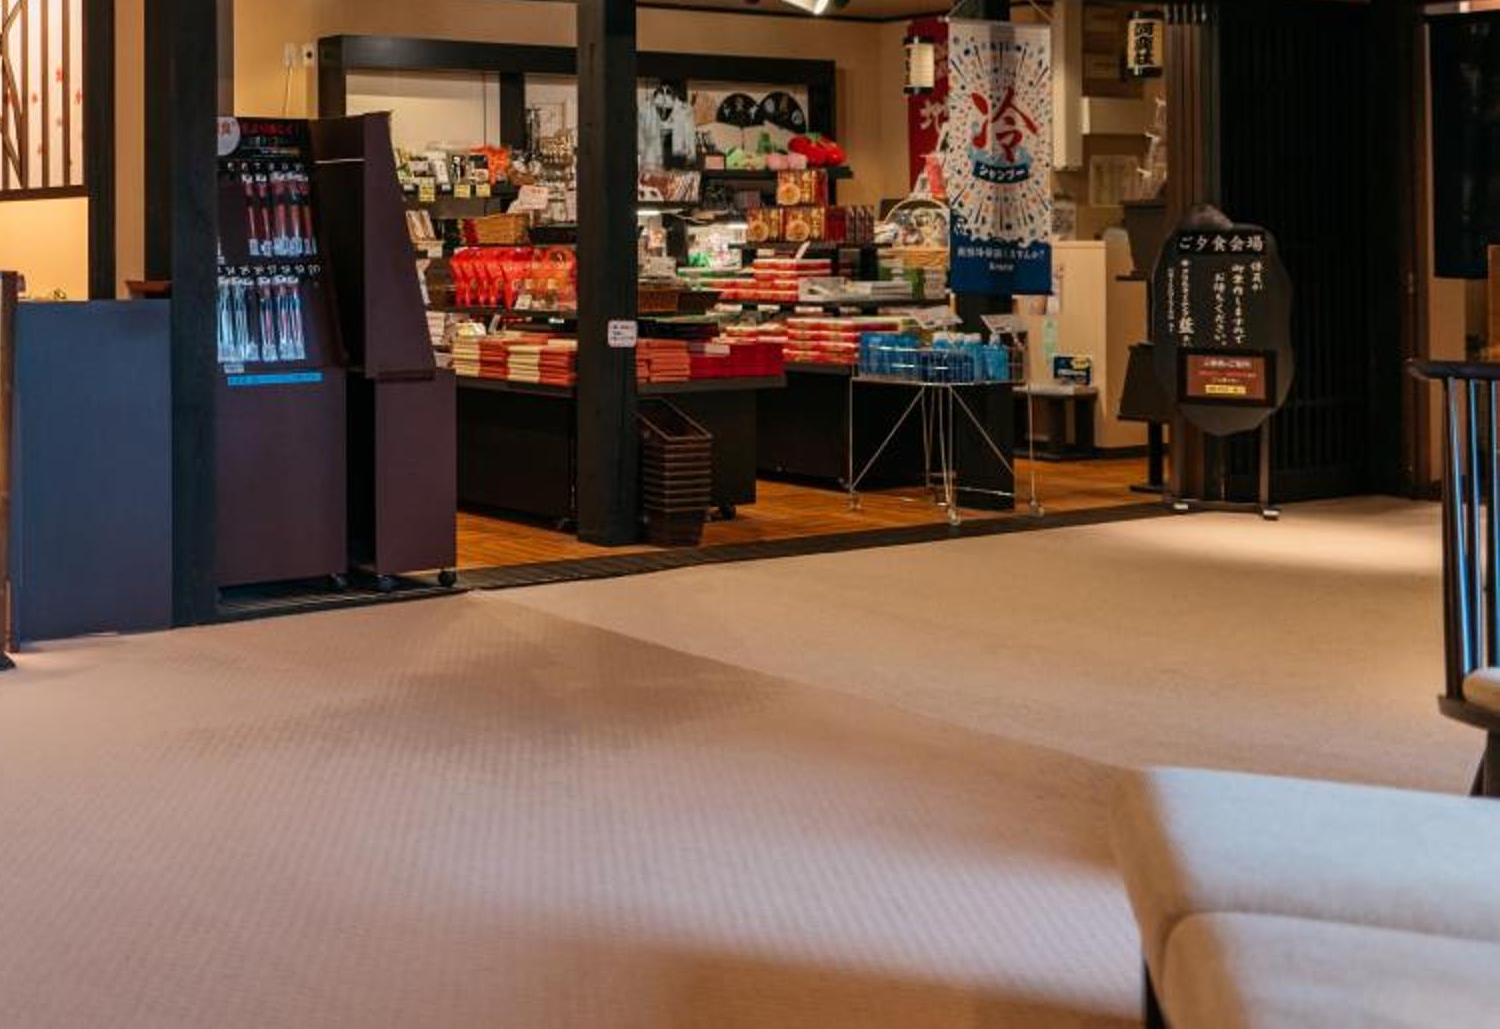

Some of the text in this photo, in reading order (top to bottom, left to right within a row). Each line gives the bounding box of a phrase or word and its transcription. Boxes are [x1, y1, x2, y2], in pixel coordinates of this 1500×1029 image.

[971, 87, 1038, 163] 冷
[978, 165, 1026, 180] シャンプー
[1178, 234, 1264, 252] ご夕食会場
